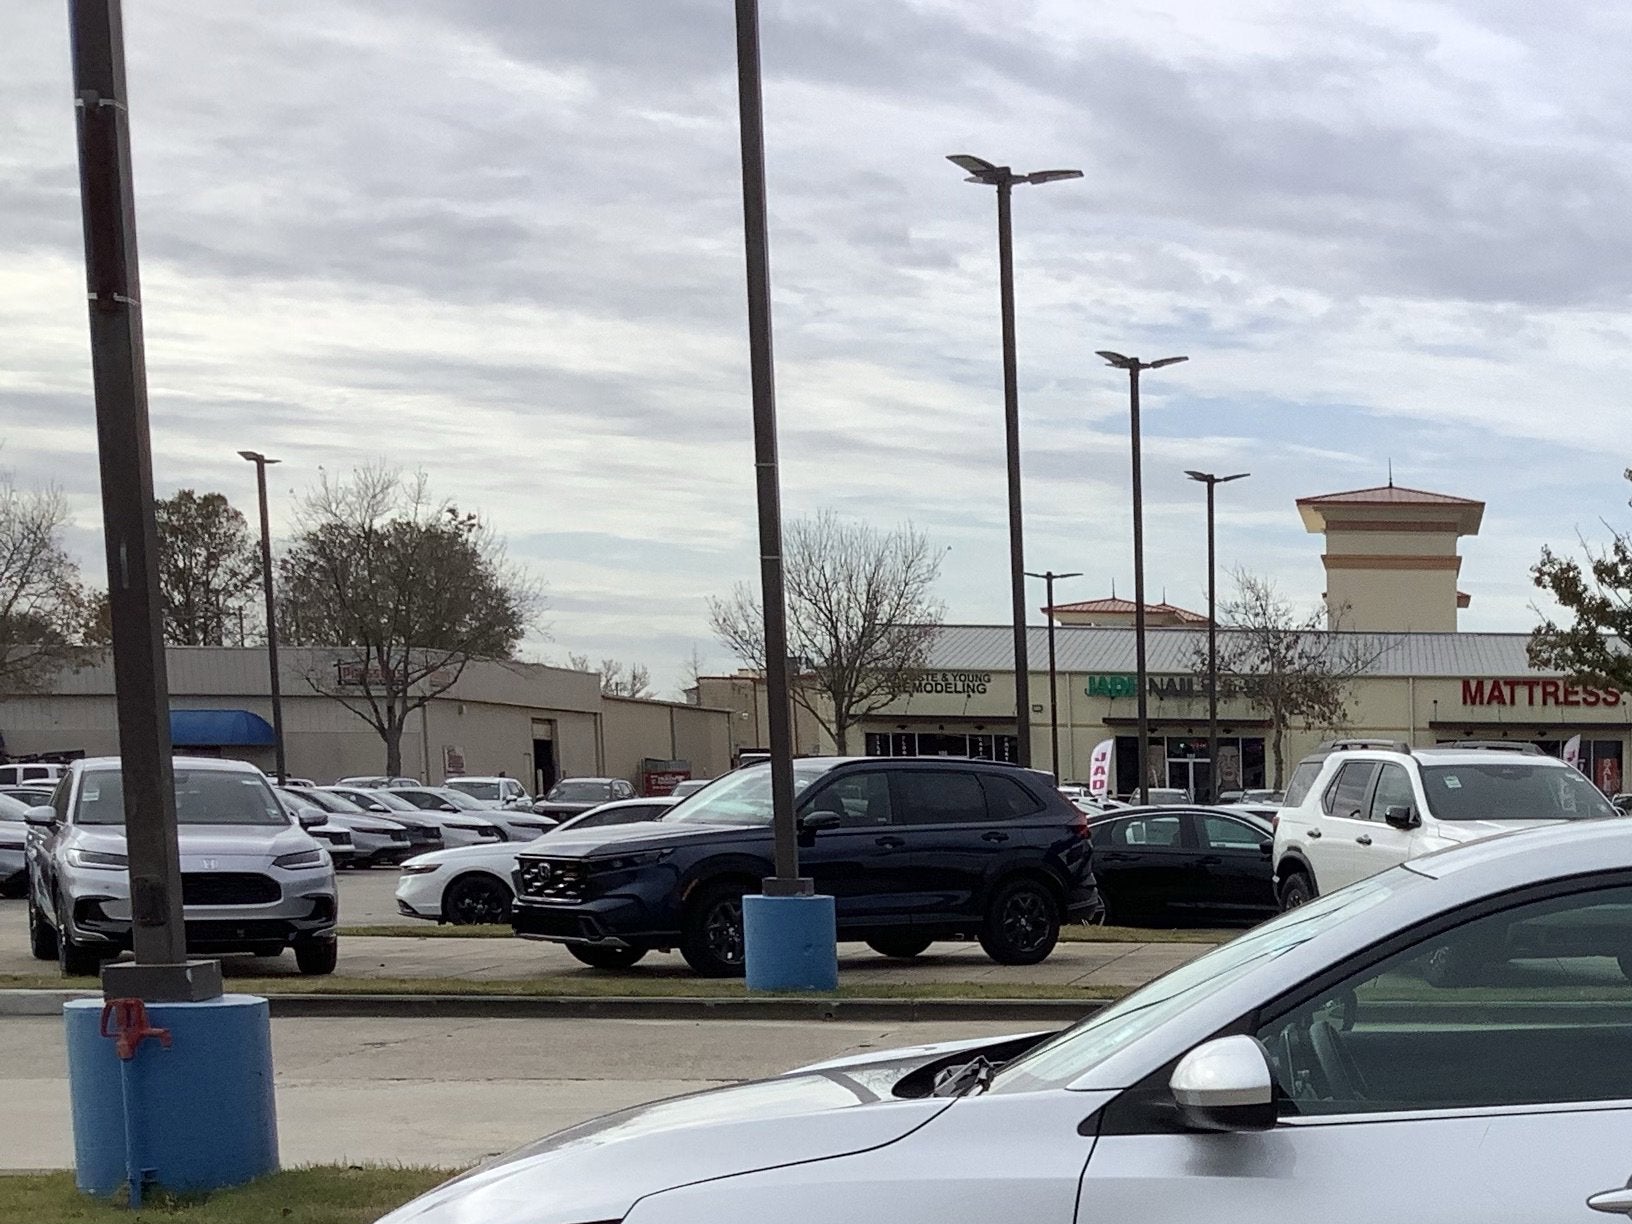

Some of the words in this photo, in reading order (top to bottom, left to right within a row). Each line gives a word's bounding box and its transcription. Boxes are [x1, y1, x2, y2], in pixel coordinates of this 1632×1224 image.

[941, 672, 949, 683] &
[952, 672, 991, 683] YOUNG
[1462, 680, 1621, 706] MATTRESS
